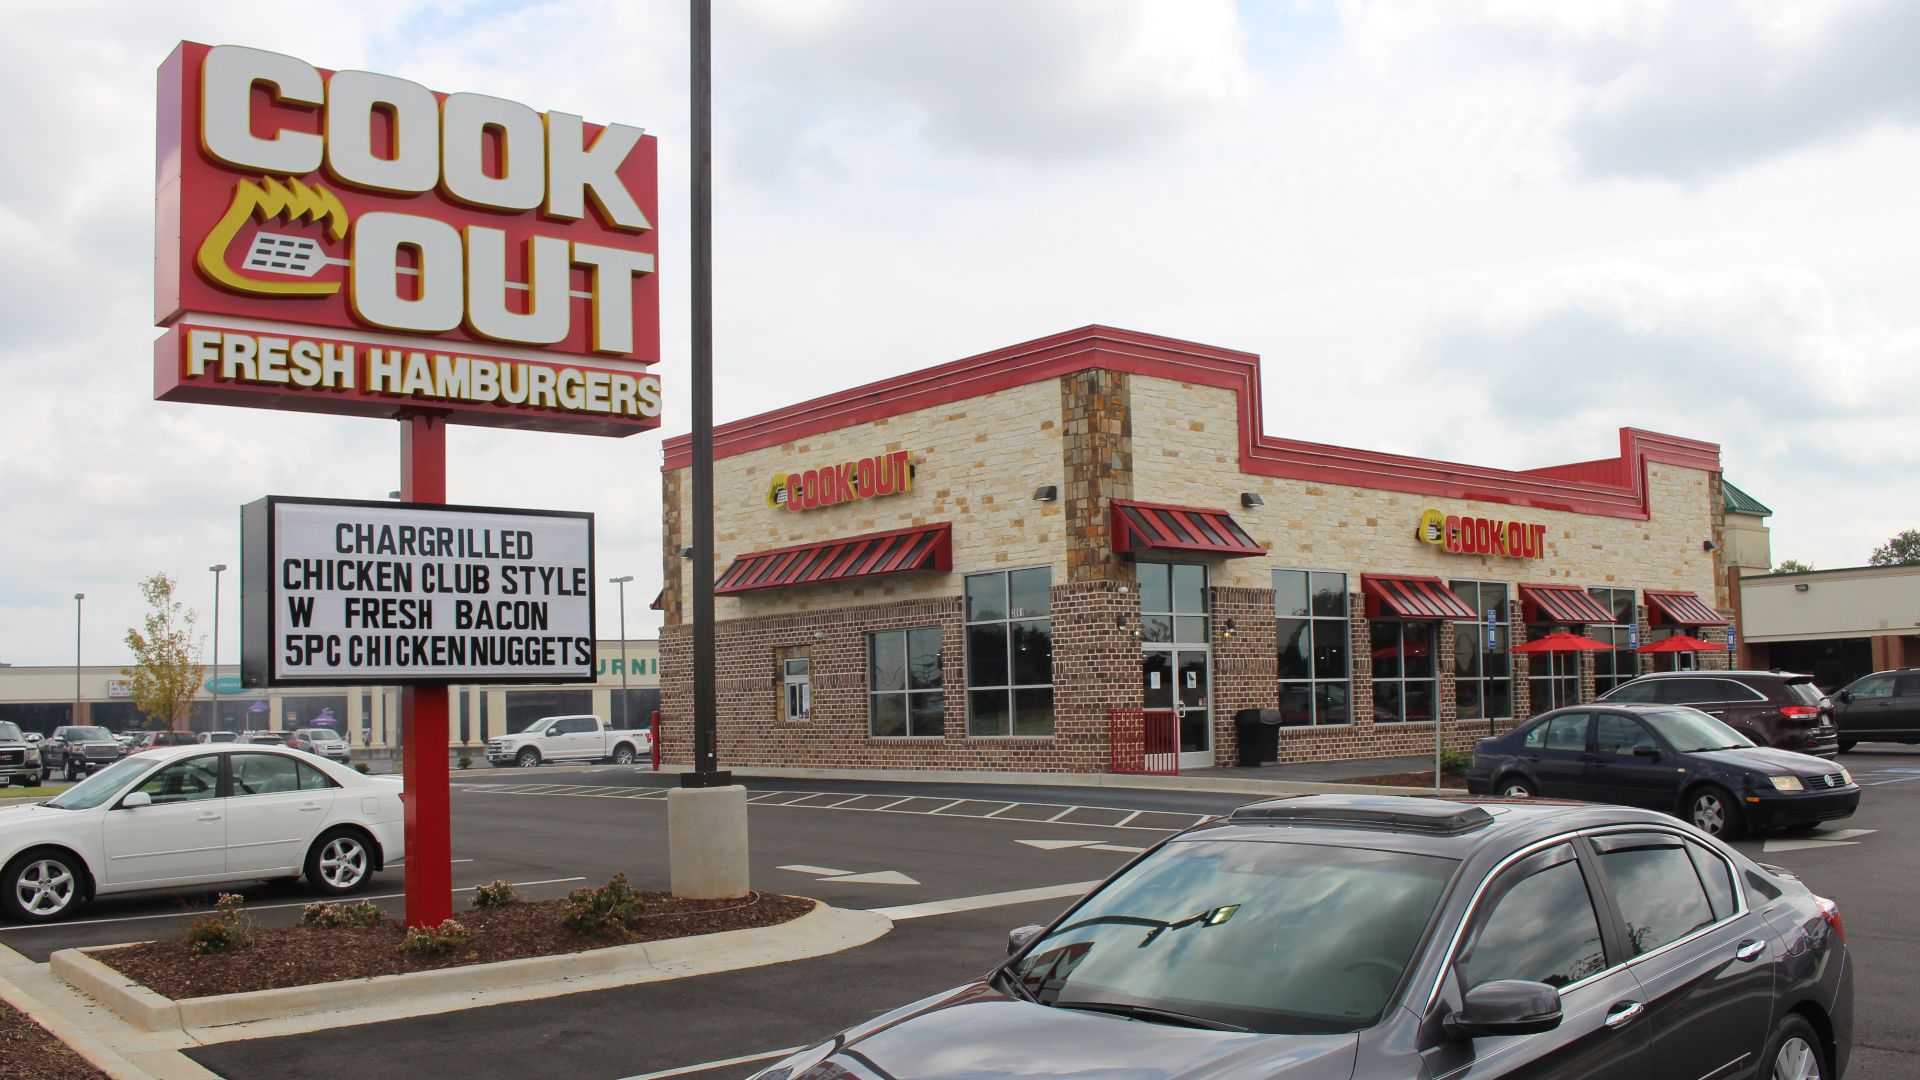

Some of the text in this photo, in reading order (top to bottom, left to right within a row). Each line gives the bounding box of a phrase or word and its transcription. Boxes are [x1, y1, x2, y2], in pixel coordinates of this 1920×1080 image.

[202, 45, 653, 232] COOK
[350, 211, 655, 355] OUT
[187, 329, 663, 418] FRESH HAMBURGERS
[787, 450, 912, 513] COOK OUT
[335, 522, 534, 560] CHARGRILLED
[1445, 514, 1547, 560] COOK OUT
[283, 558, 588, 597] CHICKEN CLUB STYLE
[287, 596, 549, 631] W FRESH BACON
[285, 634, 592, 667] 5PC CHICKEN NUGGETS
